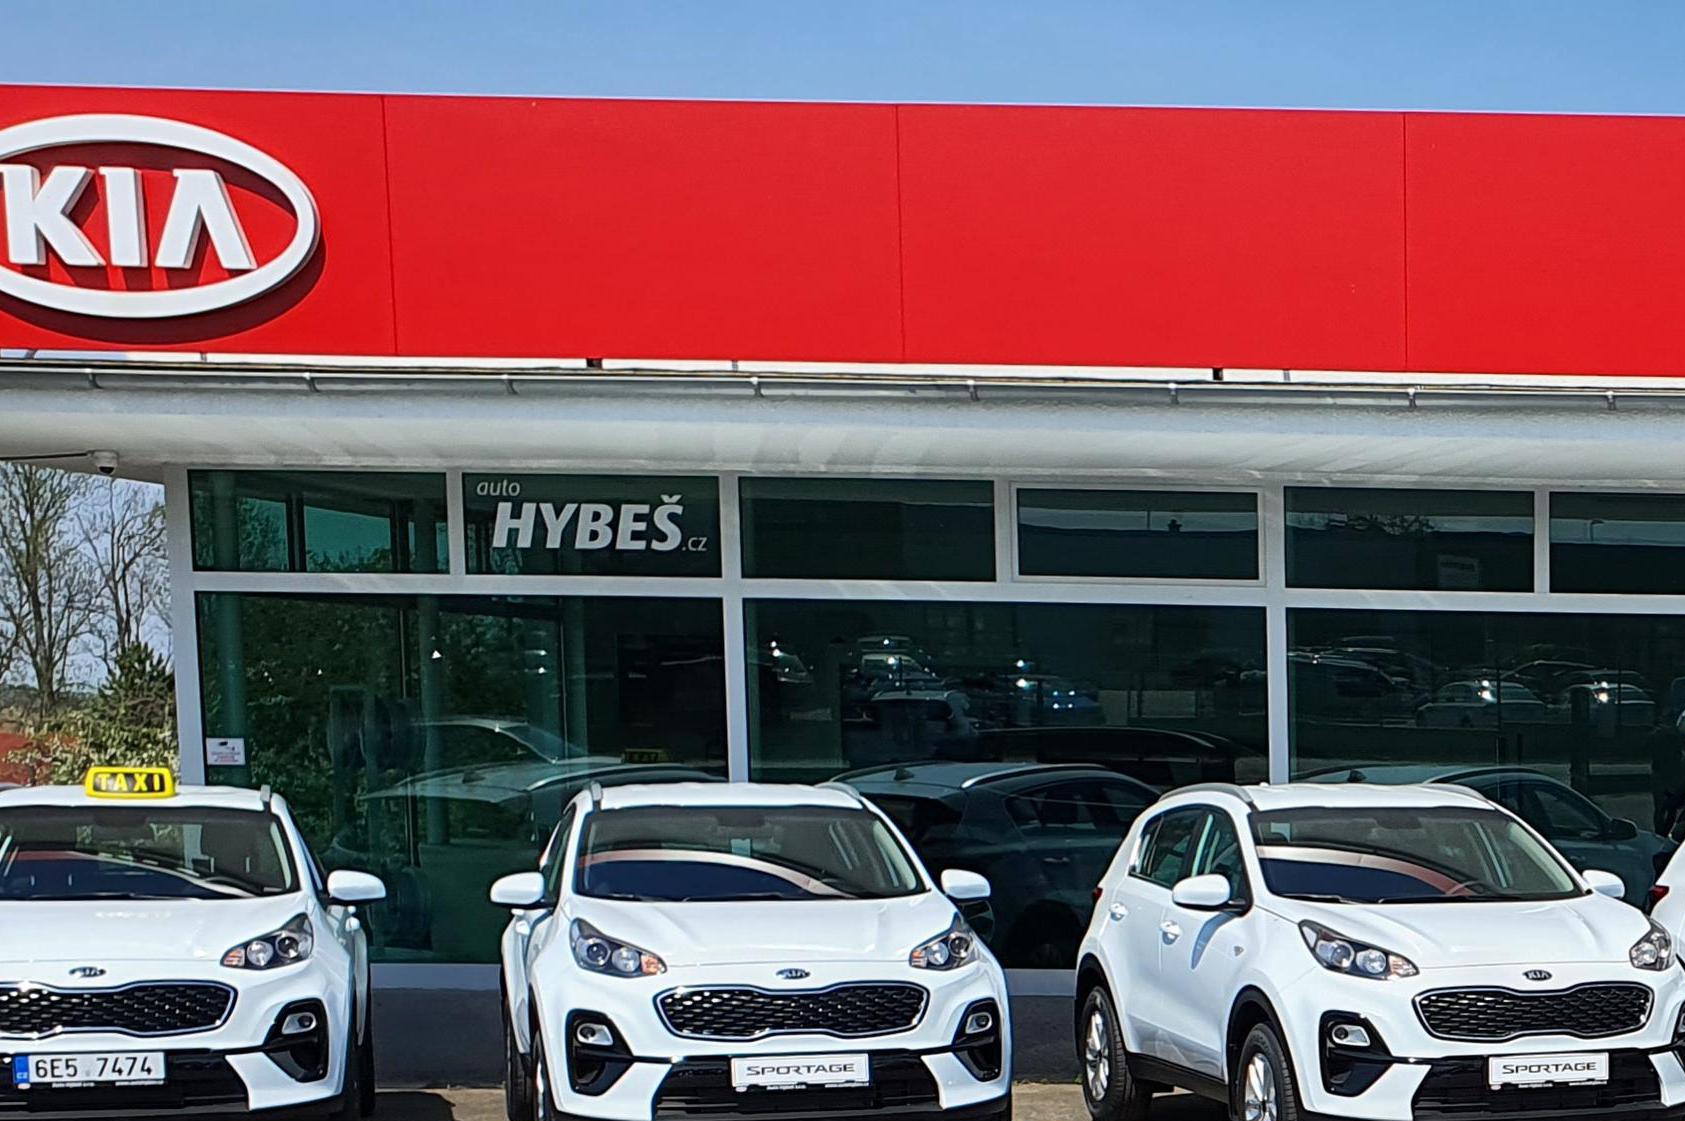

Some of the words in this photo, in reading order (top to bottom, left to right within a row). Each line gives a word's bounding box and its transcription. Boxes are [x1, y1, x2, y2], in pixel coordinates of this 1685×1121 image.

[1, 165, 257, 270] KIA
[476, 480, 521, 497] auto
[98, 773, 161, 792] TAXI
[1527, 970, 1550, 979] KIA
[35, 1057, 78, 1079] 6E5
[95, 1056, 153, 1077] 7474
[746, 1063, 856, 1077] SPORTAGE
[1502, 1061, 1598, 1075] SPORTAGE
